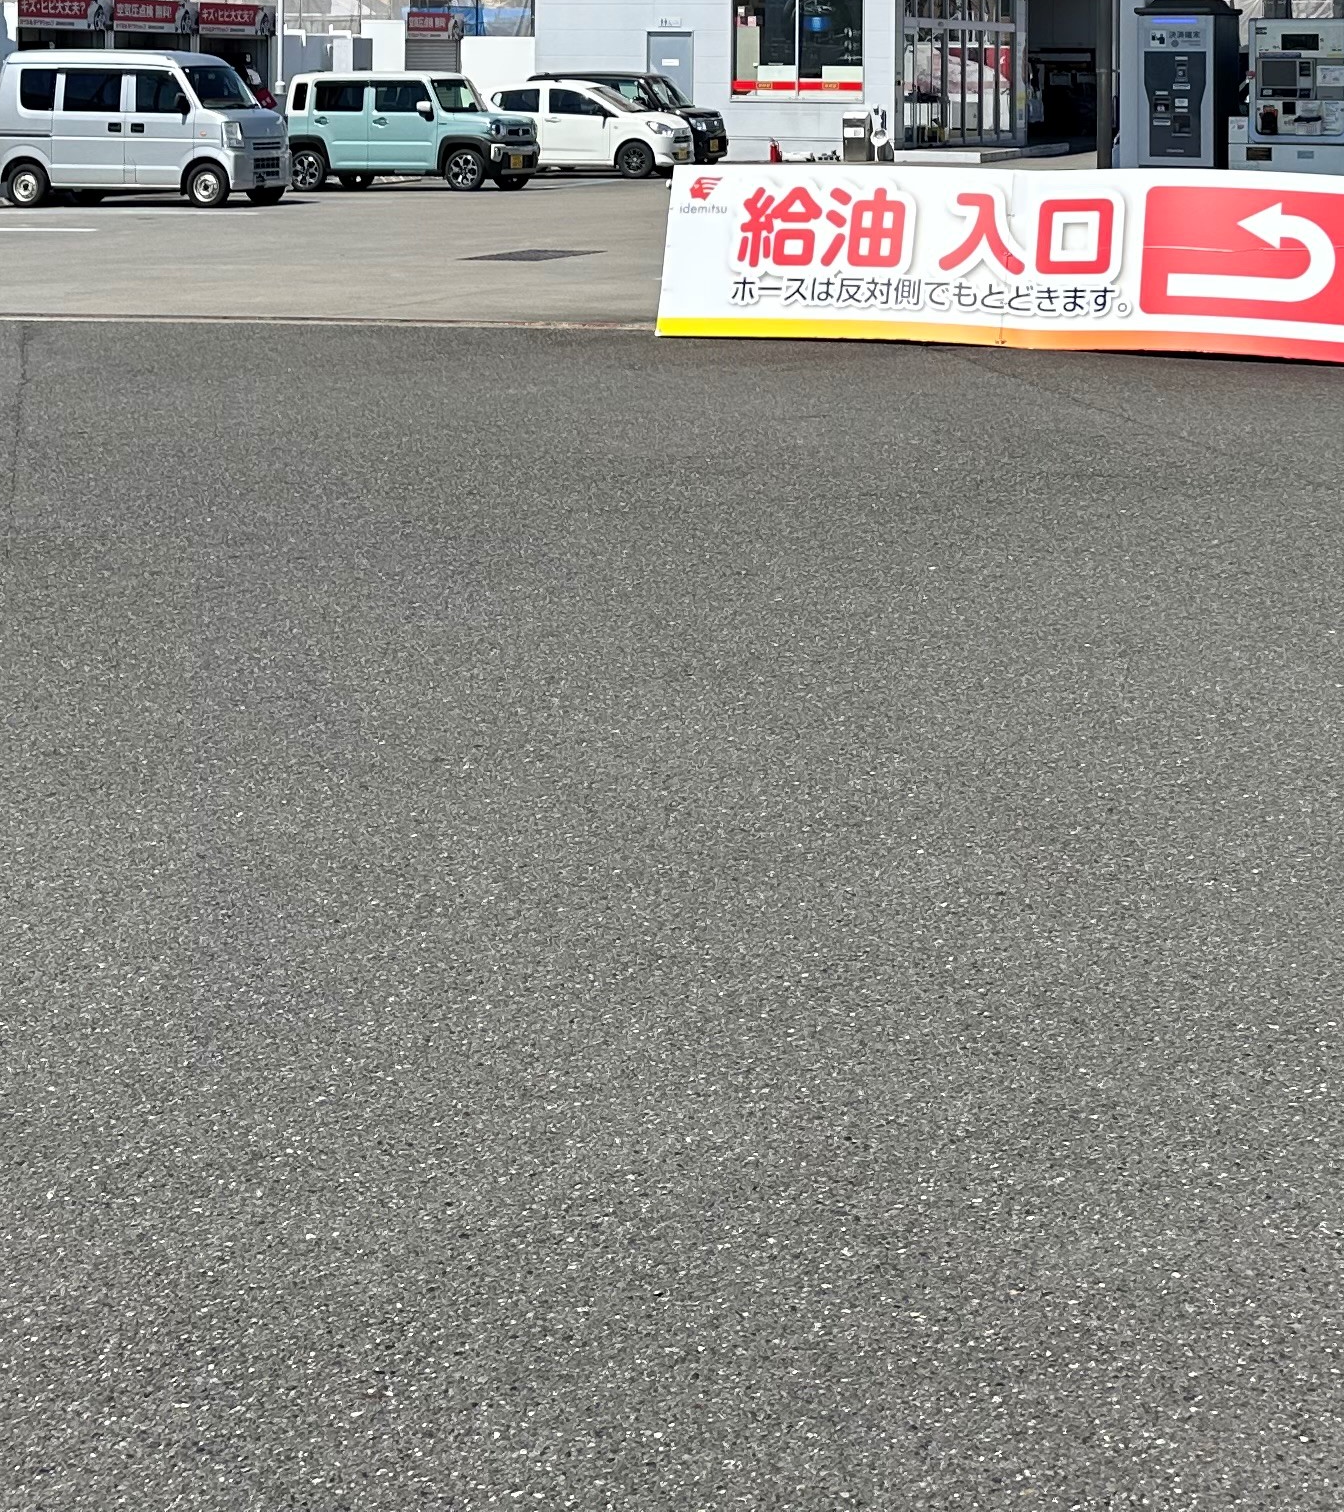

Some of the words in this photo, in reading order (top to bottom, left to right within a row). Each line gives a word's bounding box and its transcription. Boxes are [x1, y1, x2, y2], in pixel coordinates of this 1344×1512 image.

[679, 202, 728, 215] idemitsu
[737, 185, 907, 269] 給油
[938, 192, 1114, 276] 入口
[730, 276, 1132, 316] ホースは反対側でもとどきます。
